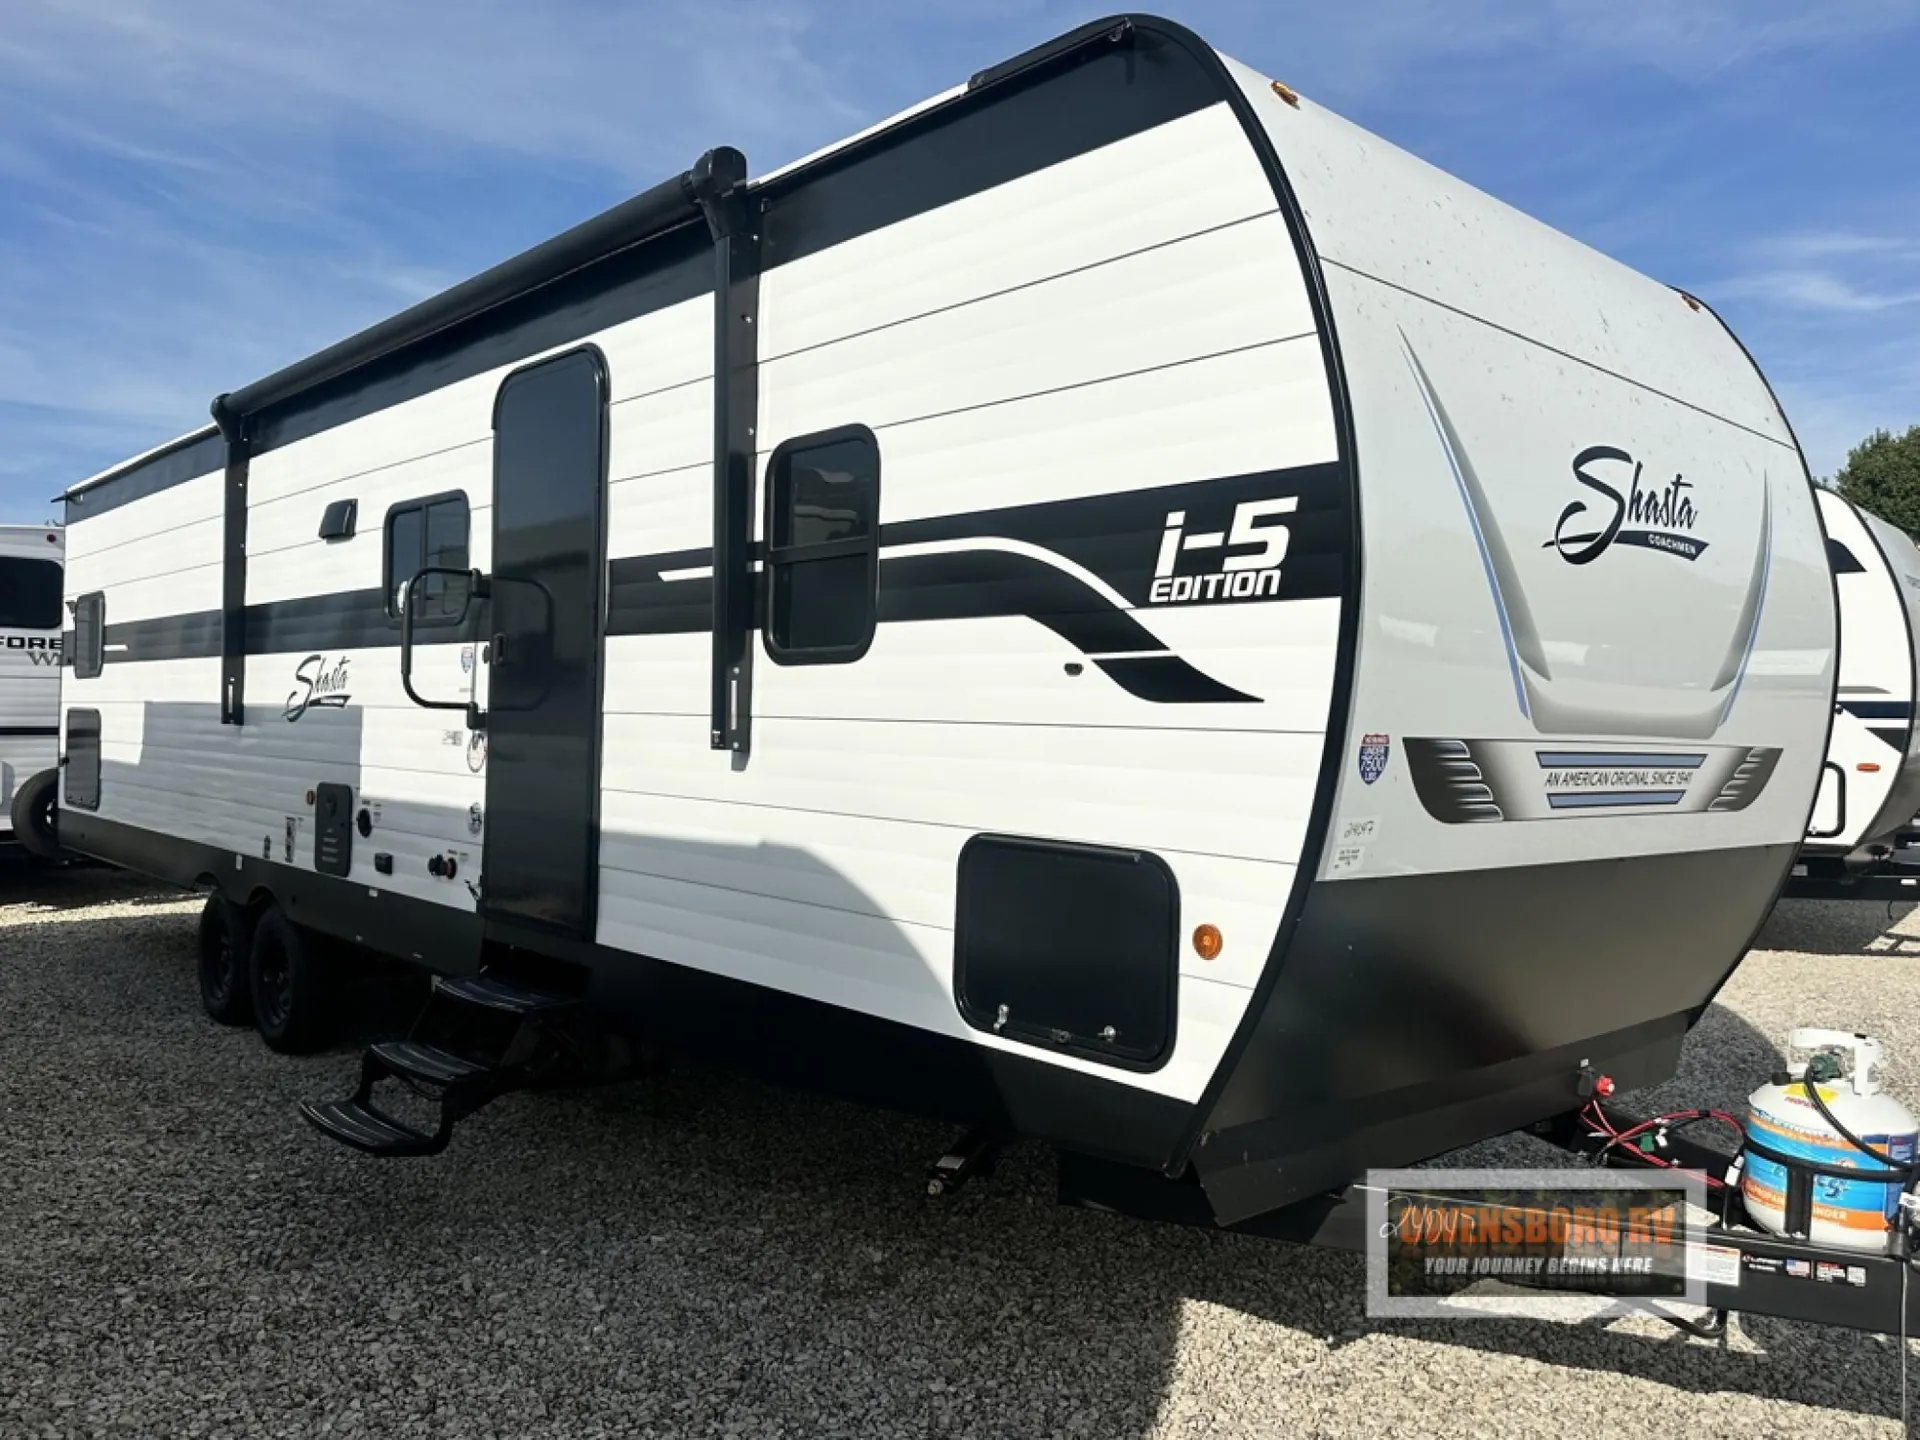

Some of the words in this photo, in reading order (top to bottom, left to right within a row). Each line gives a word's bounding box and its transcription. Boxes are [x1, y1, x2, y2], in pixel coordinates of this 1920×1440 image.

[1553, 445, 1699, 565] Shasta
[1647, 534, 1697, 554] COACHMEN
[1149, 569, 1282, 602] EDITION
[0, 634, 62, 650] ORE
[286, 654, 351, 723] Shasta
[1560, 771, 1611, 787] AMERICAN
[1610, 771, 1651, 786] ORIGINAL
[1649, 771, 1677, 785] SINCE
